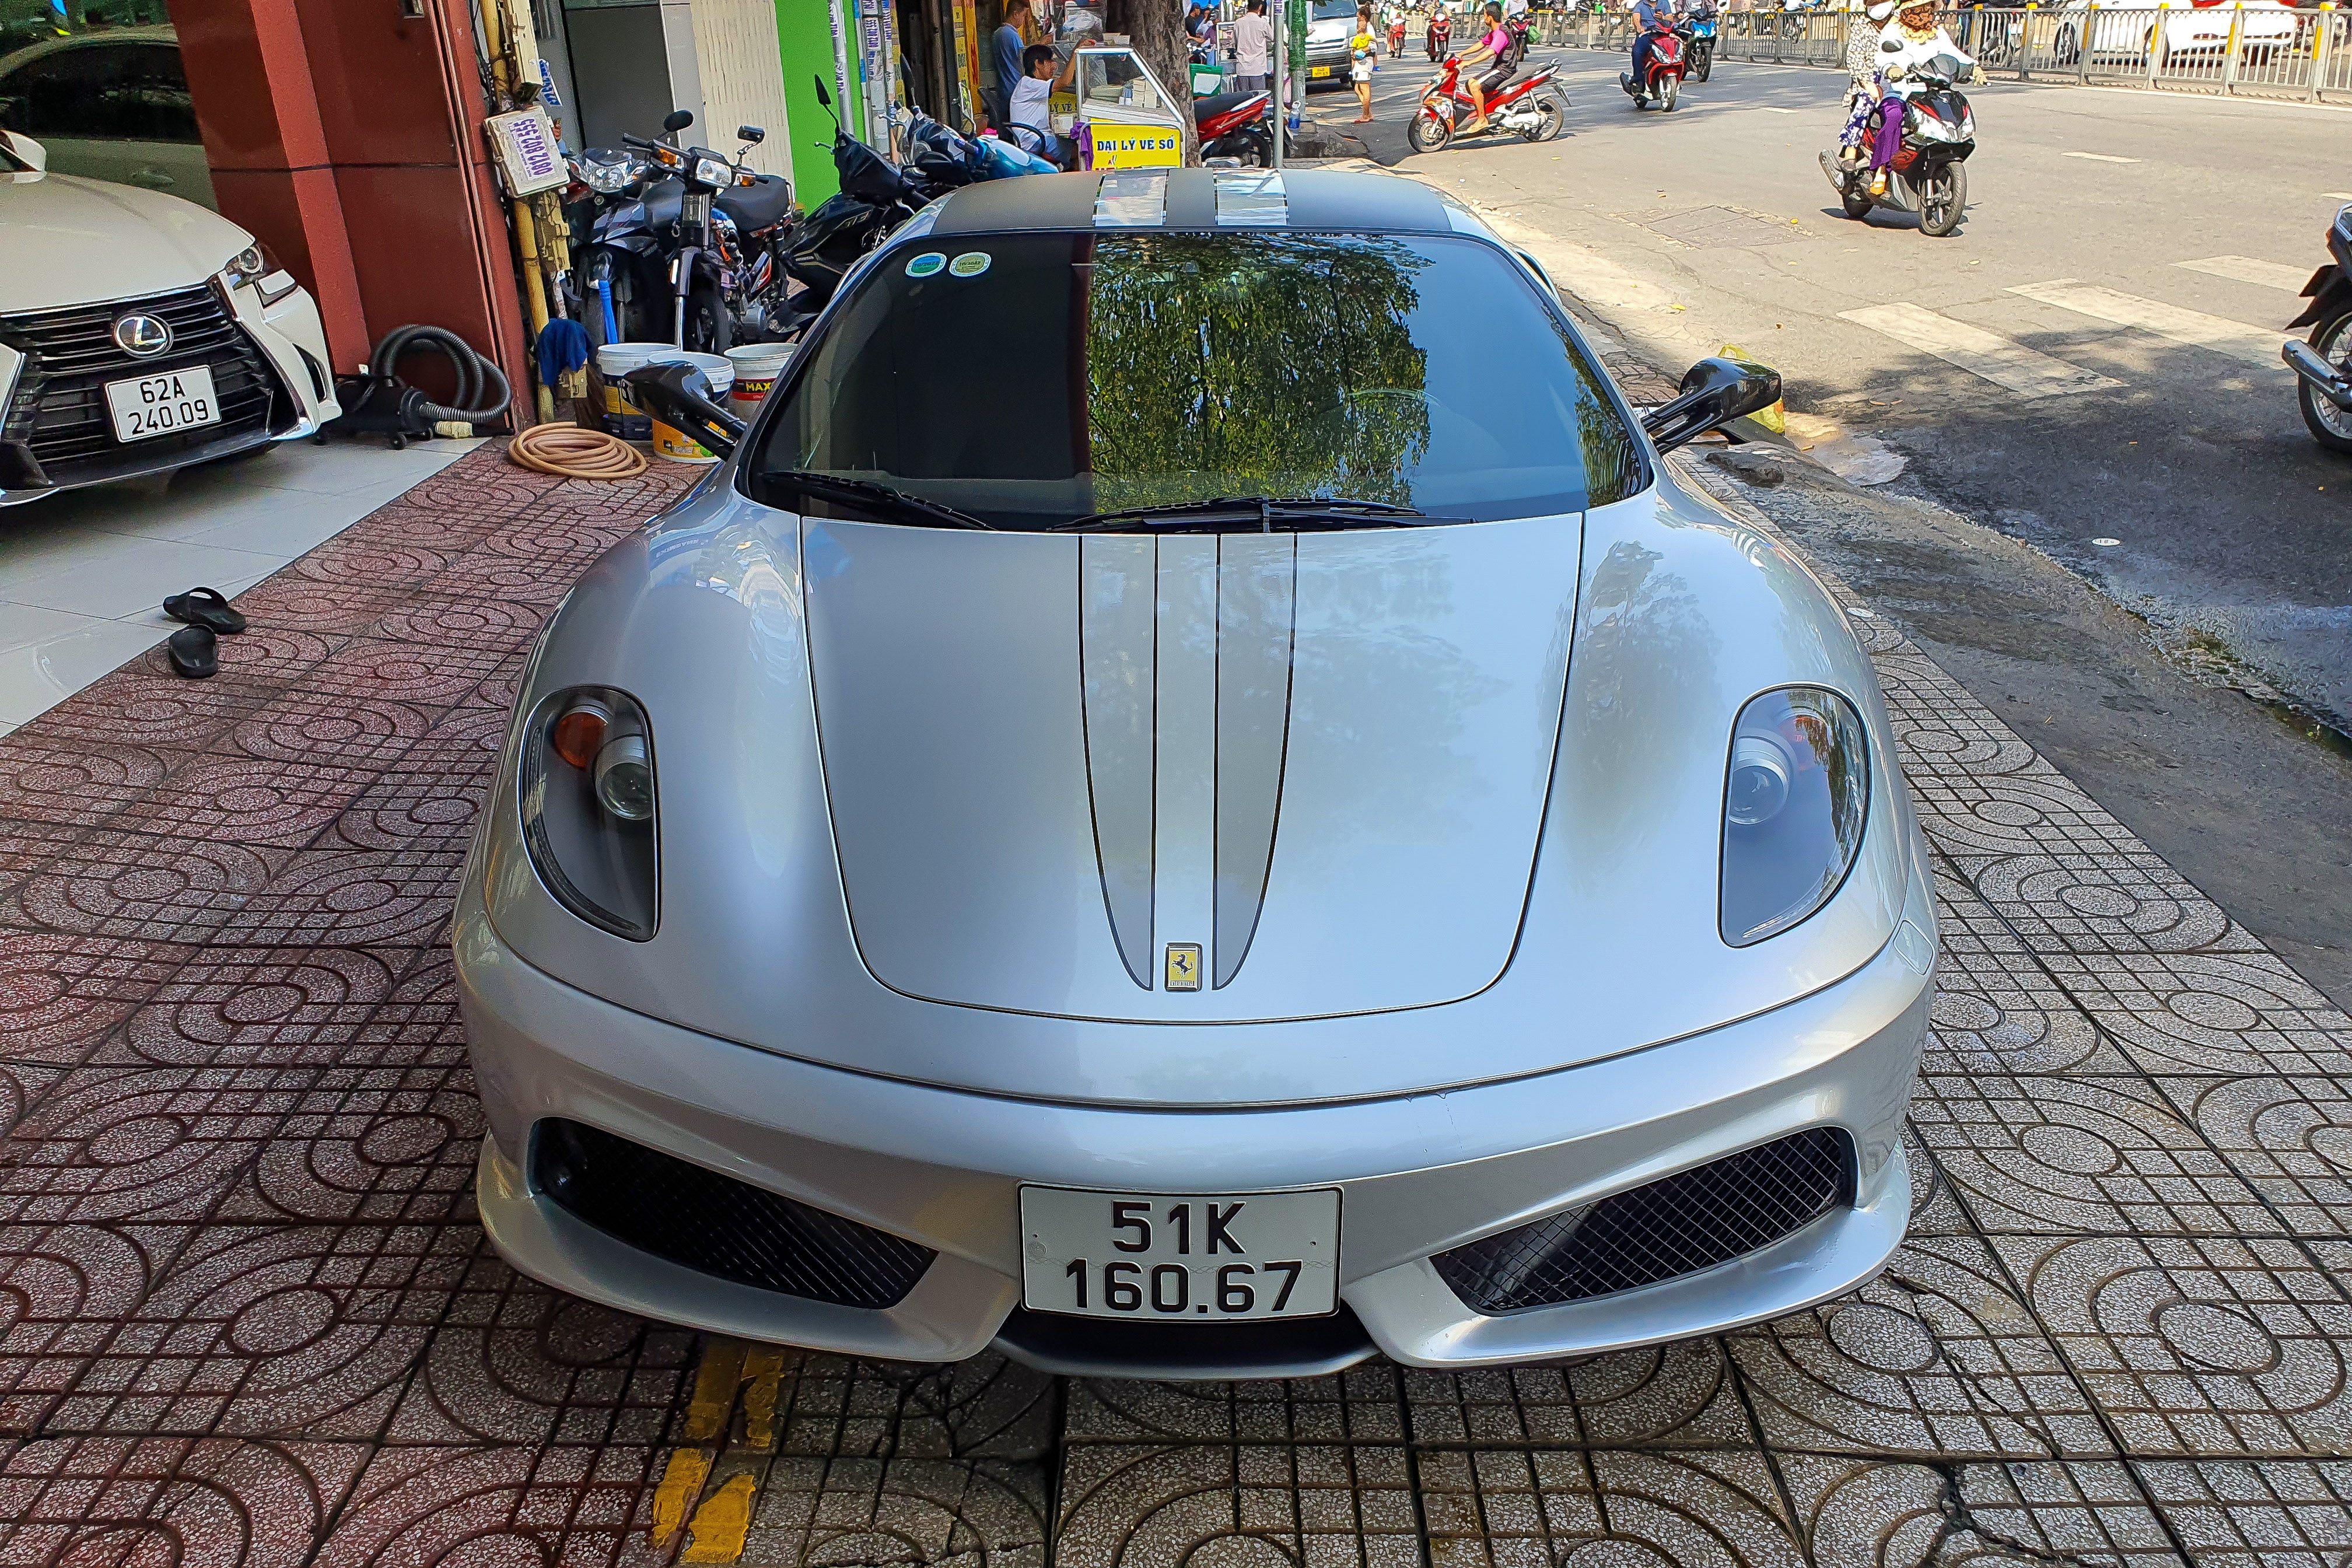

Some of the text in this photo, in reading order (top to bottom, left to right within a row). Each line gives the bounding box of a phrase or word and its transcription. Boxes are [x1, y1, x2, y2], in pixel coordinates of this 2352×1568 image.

[513, 118, 538, 136] 555
[521, 135, 545, 154] 802
[1121, 136, 1136, 150] LÝ
[1158, 135, 1174, 149] SỐ
[527, 152, 553, 175] 0812
[140, 376, 186, 404] 62A
[128, 399, 209, 435] 240.09
[1112, 1200, 1246, 1255] 51K
[1066, 1258, 1303, 1314] 160.67
